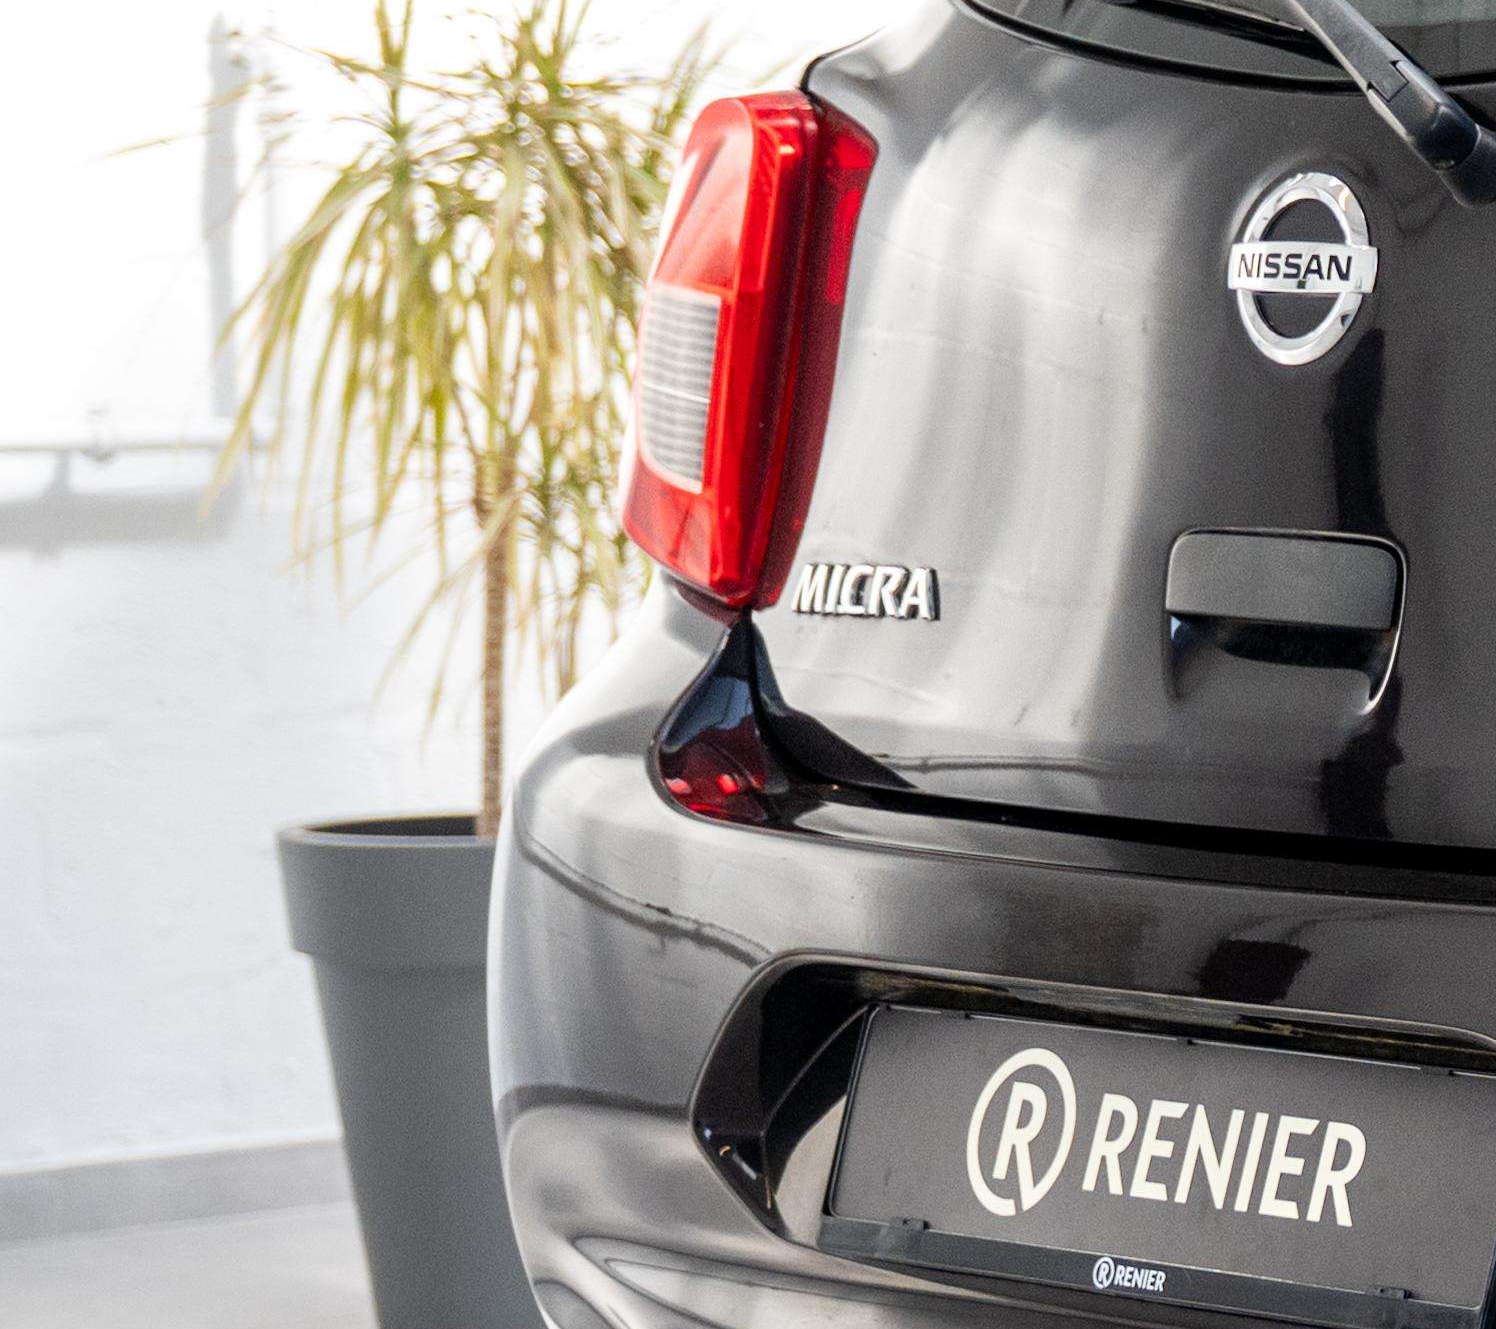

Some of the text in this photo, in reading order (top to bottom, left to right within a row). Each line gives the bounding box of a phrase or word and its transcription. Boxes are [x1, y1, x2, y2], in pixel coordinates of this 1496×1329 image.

[1237, 252, 1353, 281] NISSAN
[791, 562, 941, 621] MICRA
[1082, 1092, 1367, 1228] RENIER
[1114, 1264, 1167, 1292] RENIER
